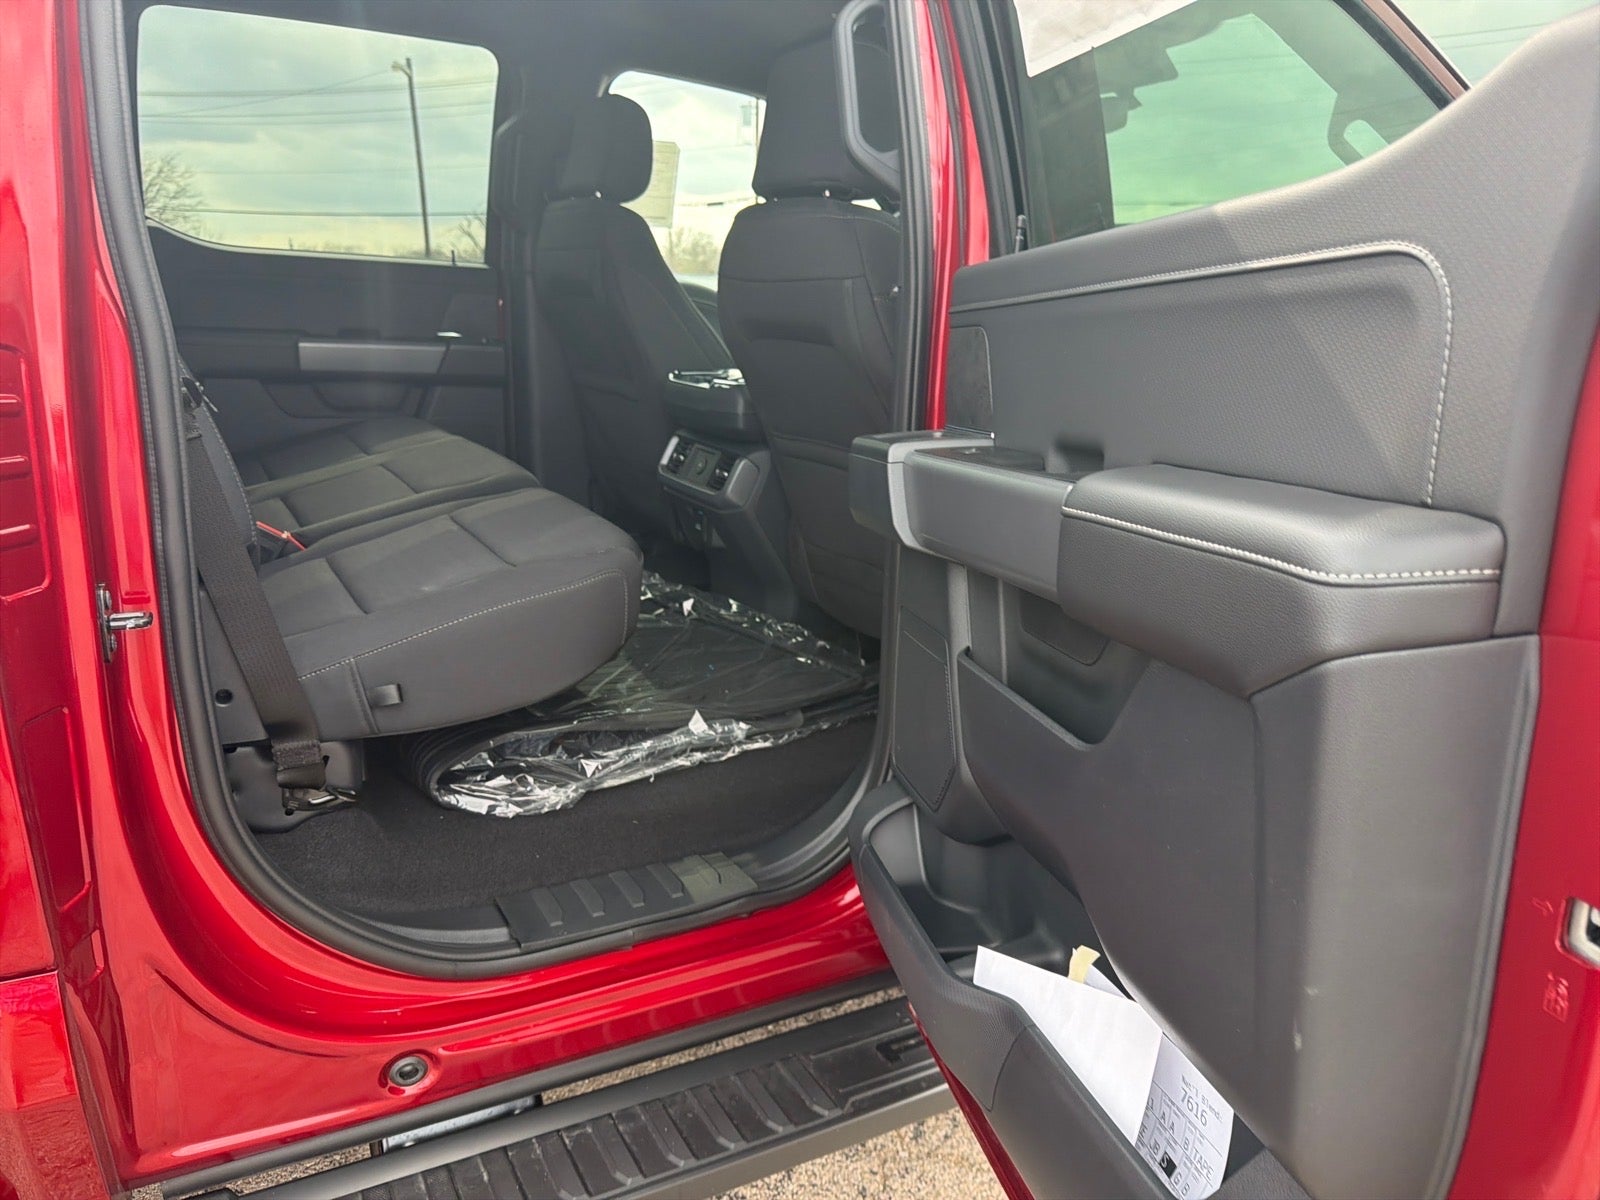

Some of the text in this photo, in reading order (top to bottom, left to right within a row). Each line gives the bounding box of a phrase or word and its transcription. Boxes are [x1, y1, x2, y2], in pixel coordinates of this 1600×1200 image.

[1181, 1086, 1208, 1127] 7616
[1160, 1111, 1166, 1124] A
[1169, 1120, 1175, 1134] A
[1183, 1136, 1190, 1151] B
[1193, 1147, 1214, 1181] TAPE
[1160, 1153, 1170, 1168] S
